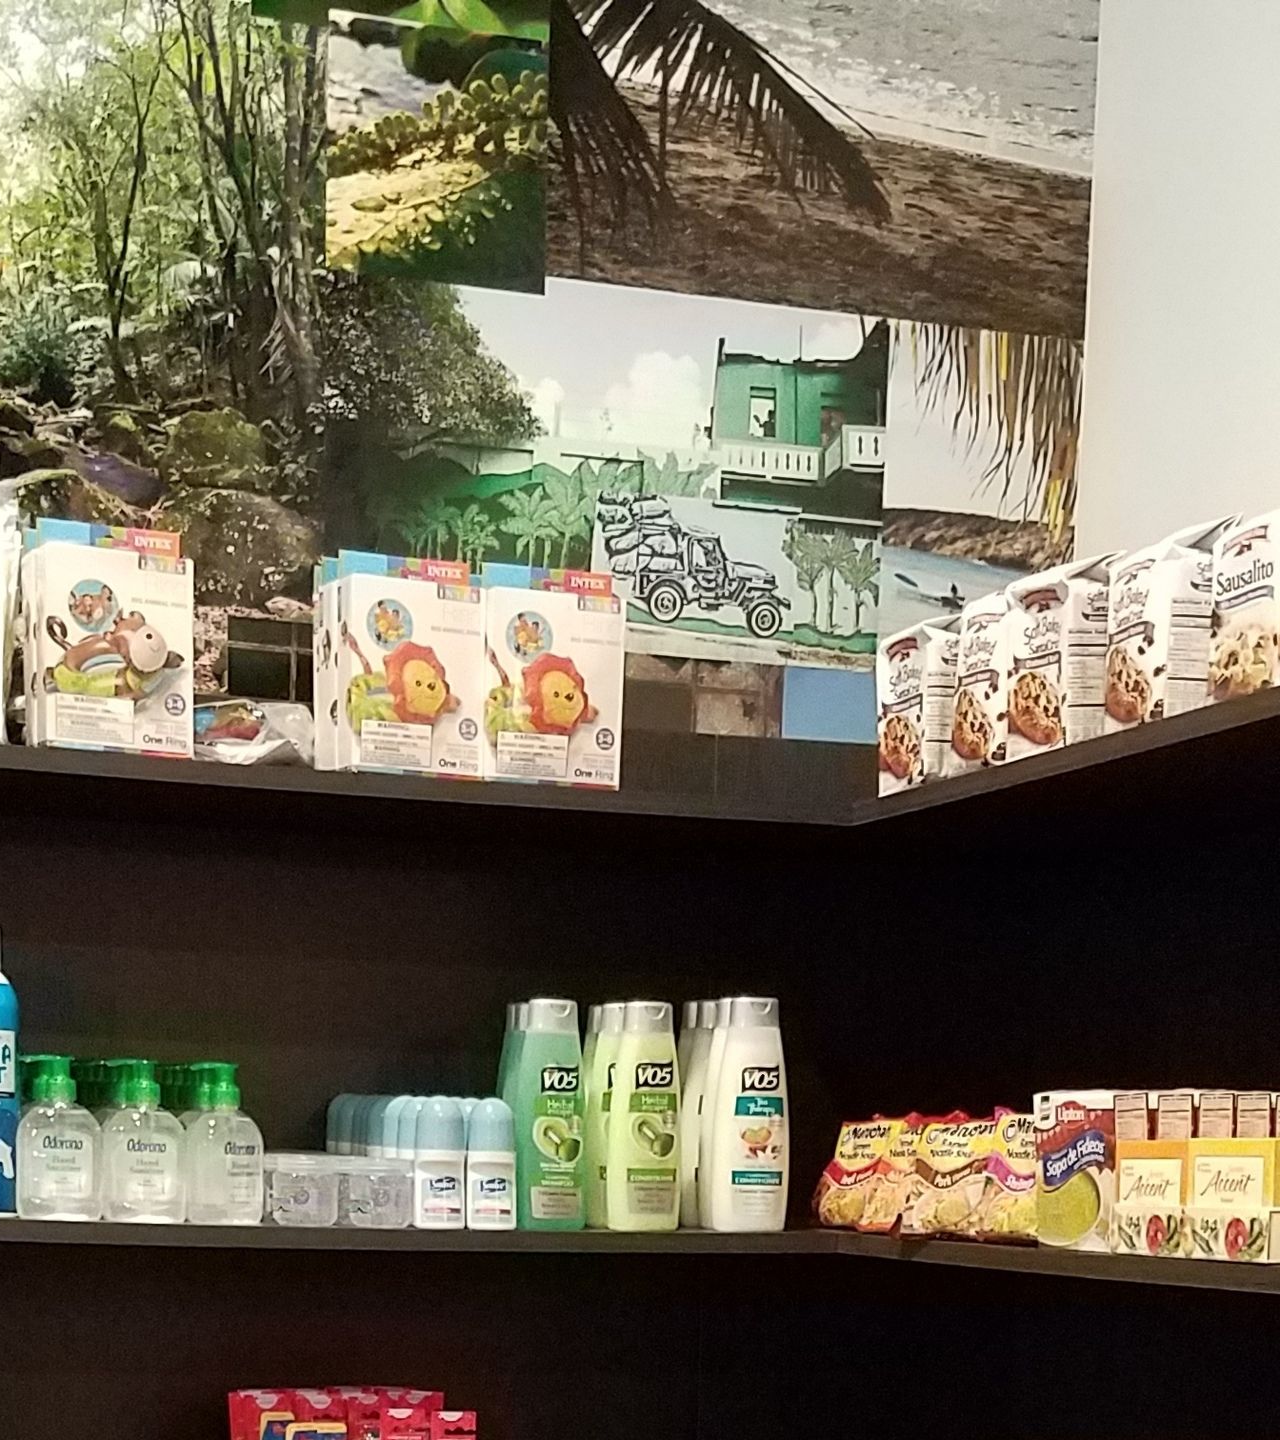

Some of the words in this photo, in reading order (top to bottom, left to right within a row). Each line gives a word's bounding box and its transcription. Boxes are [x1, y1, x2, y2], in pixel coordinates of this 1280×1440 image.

[134, 536, 172, 550] INTEX
[427, 565, 464, 580] INTEX
[1215, 558, 1274, 597] Sausalito
[571, 576, 607, 591] INTEX
[142, 733, 164, 745] One
[165, 736, 188, 749] Ring
[438, 758, 457, 769] One
[459, 760, 479, 773] Ring
[574, 767, 593, 779] One
[594, 768, 615, 782] Ring
[542, 1070, 577, 1090] VO5
[637, 1066, 673, 1086] VO5
[743, 1069, 779, 1090] VO5
[1057, 1106, 1085, 1123] Lipton
[42, 1135, 84, 1151] Odorono
[126, 1138, 167, 1154] Odorono
[1046, 1156, 1069, 1179] Sopa
[1066, 1146, 1078, 1163] de
[1077, 1137, 1107, 1156] Fideos
